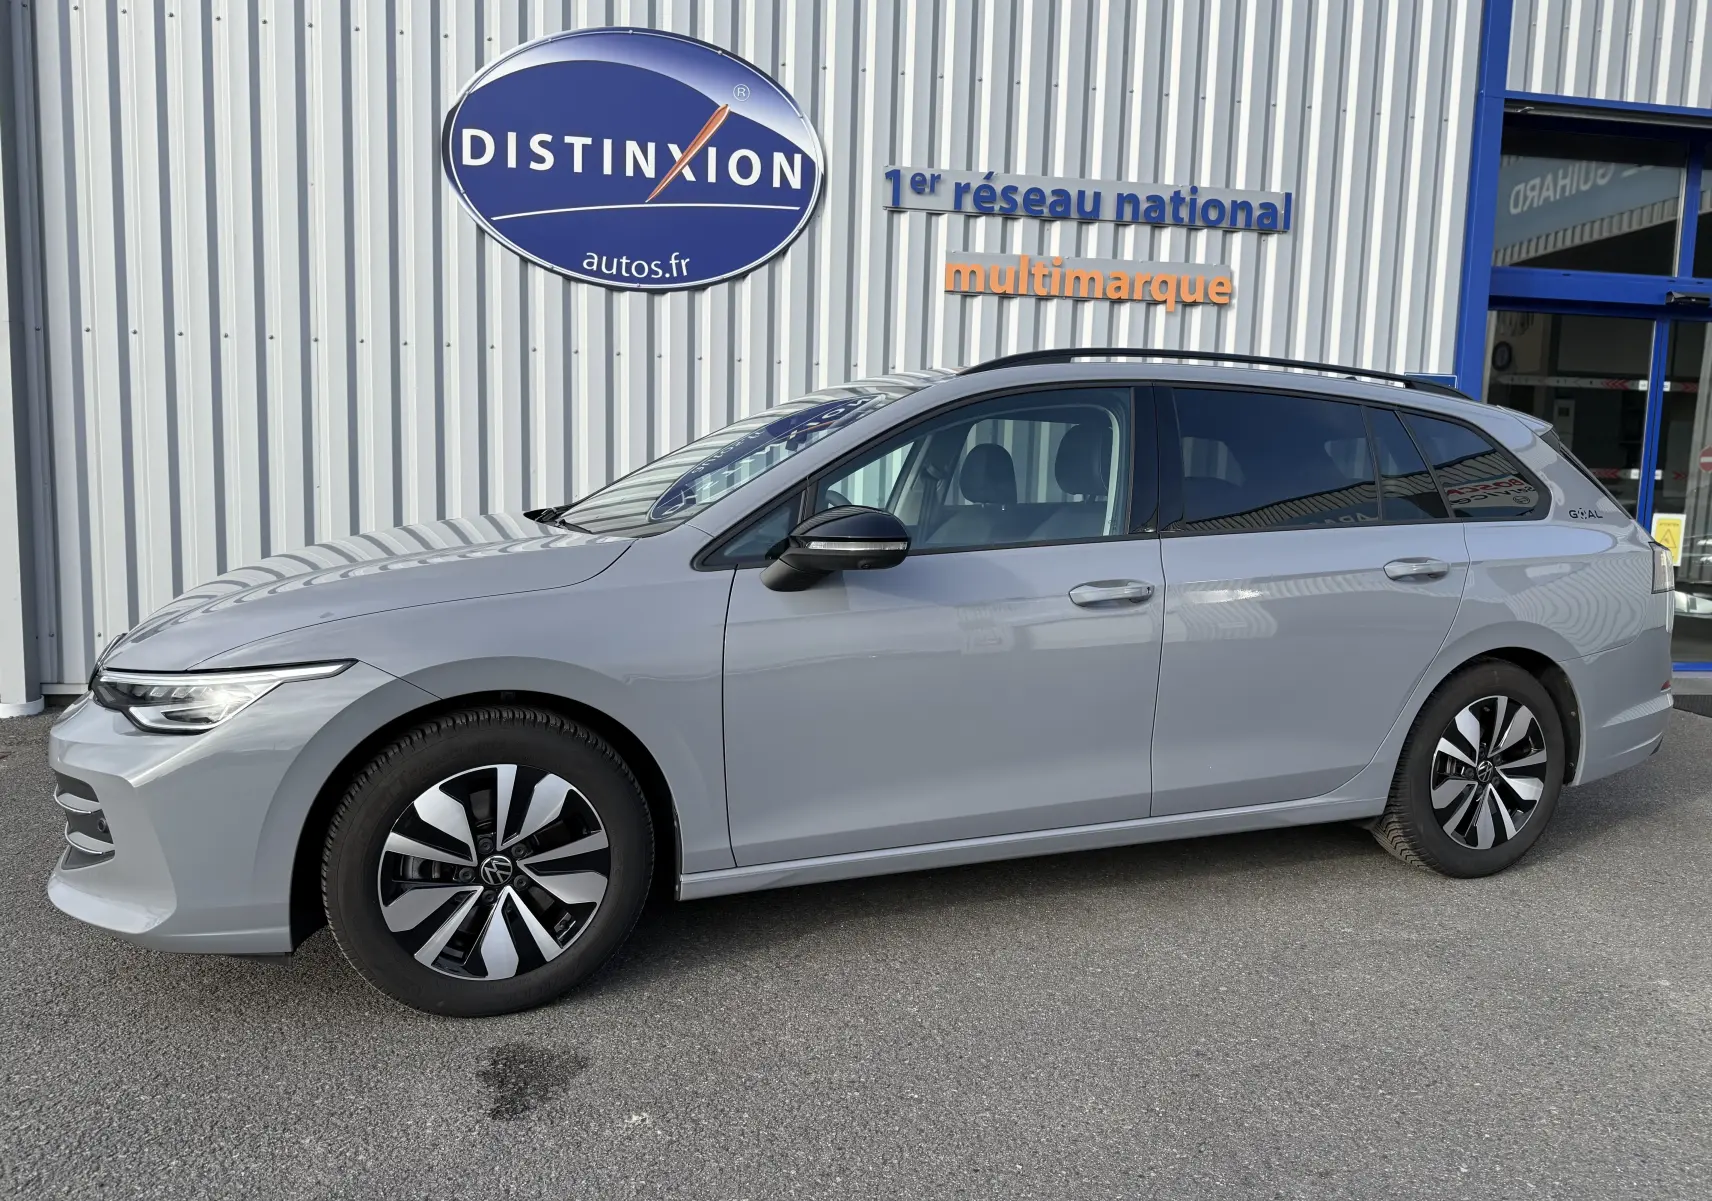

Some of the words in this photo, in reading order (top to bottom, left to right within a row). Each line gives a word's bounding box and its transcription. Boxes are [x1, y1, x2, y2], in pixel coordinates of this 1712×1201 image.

[462, 128, 803, 190] DISTINXION
[884, 169, 942, 207] 1er
[953, 171, 1101, 218] réseau
[1116, 185, 1293, 231] national
[582, 252, 691, 278] autos.fr
[945, 255, 1233, 312] multimarque
[1568, 508, 1603, 519] GOAL
